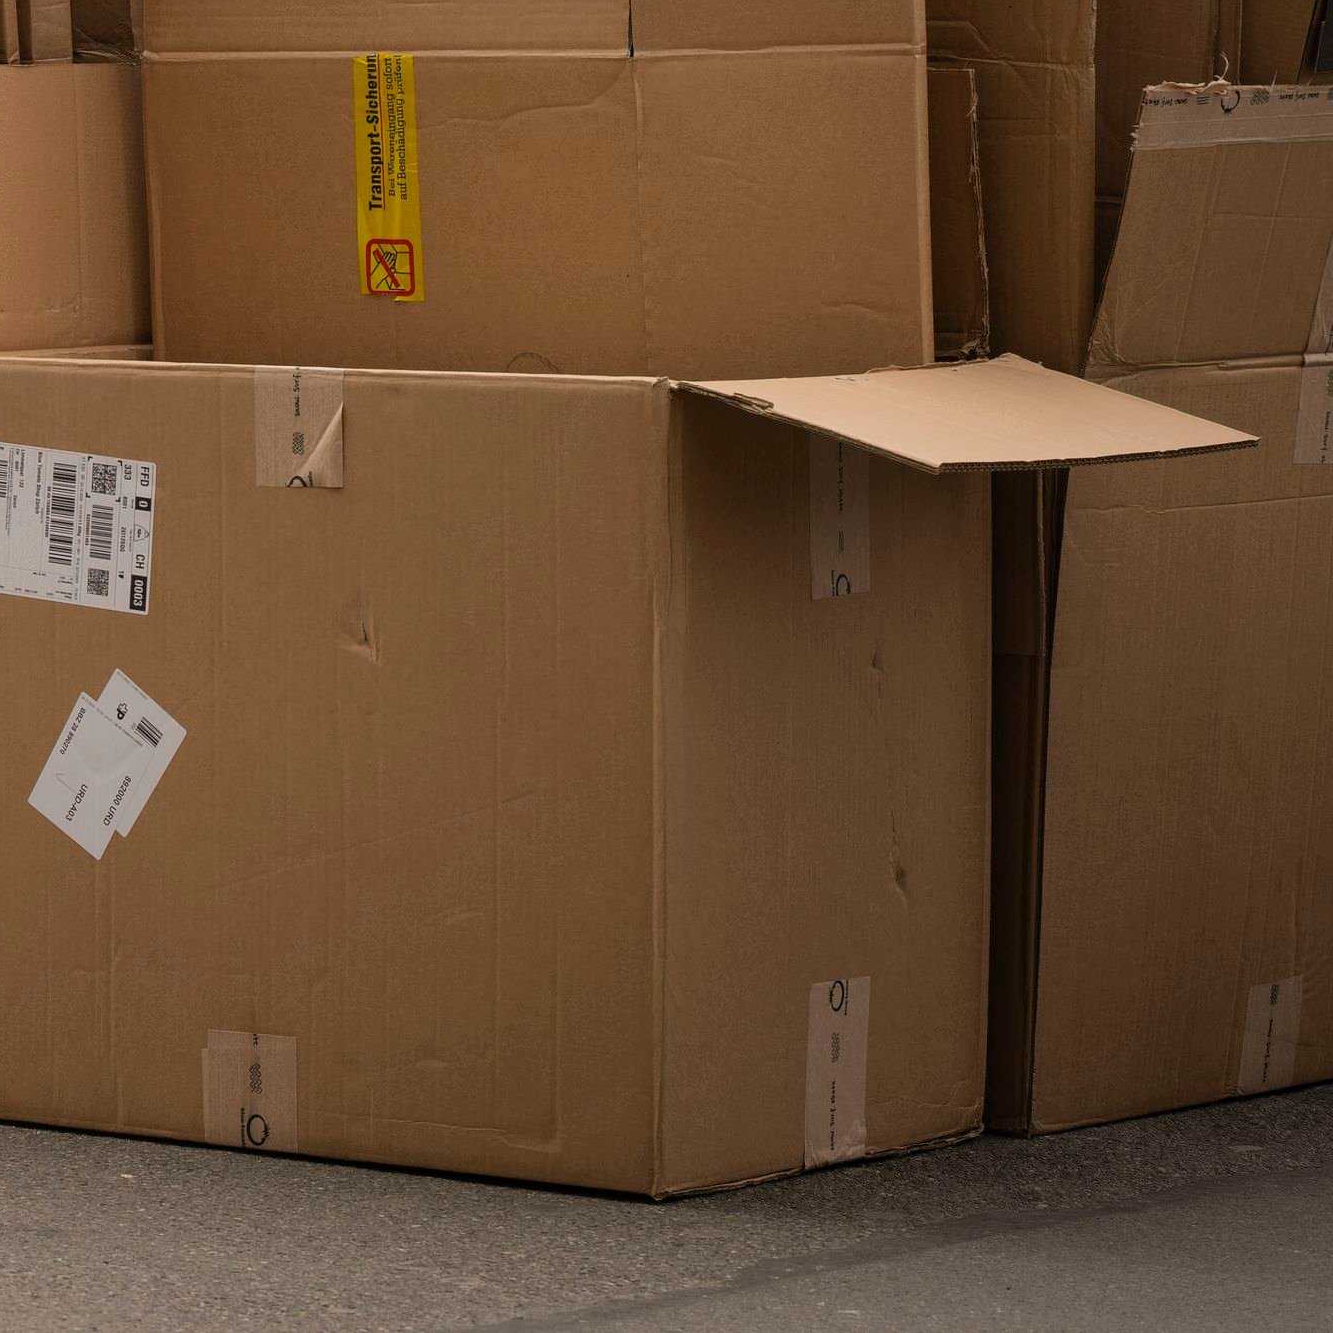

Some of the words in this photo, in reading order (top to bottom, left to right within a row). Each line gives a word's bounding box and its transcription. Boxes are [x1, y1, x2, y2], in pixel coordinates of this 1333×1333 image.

[382, 57, 393, 91] sofort
[384, 94, 398, 176] Wareneingang
[394, 98, 408, 181] Beschädigung
[387, 177, 396, 198] Bei
[397, 182, 408, 201] auf
[123, 463, 132, 481] 333
[140, 465, 150, 487] FFD
[135, 553, 146, 570] CH
[132, 577, 146, 608] 0003
[74, 706, 88, 724] BBZ
[59, 731, 75, 755] 890270
[113, 775, 133, 806] 892000
[64, 783, 89, 822] URD-A03
[102, 805, 117, 826] URD
